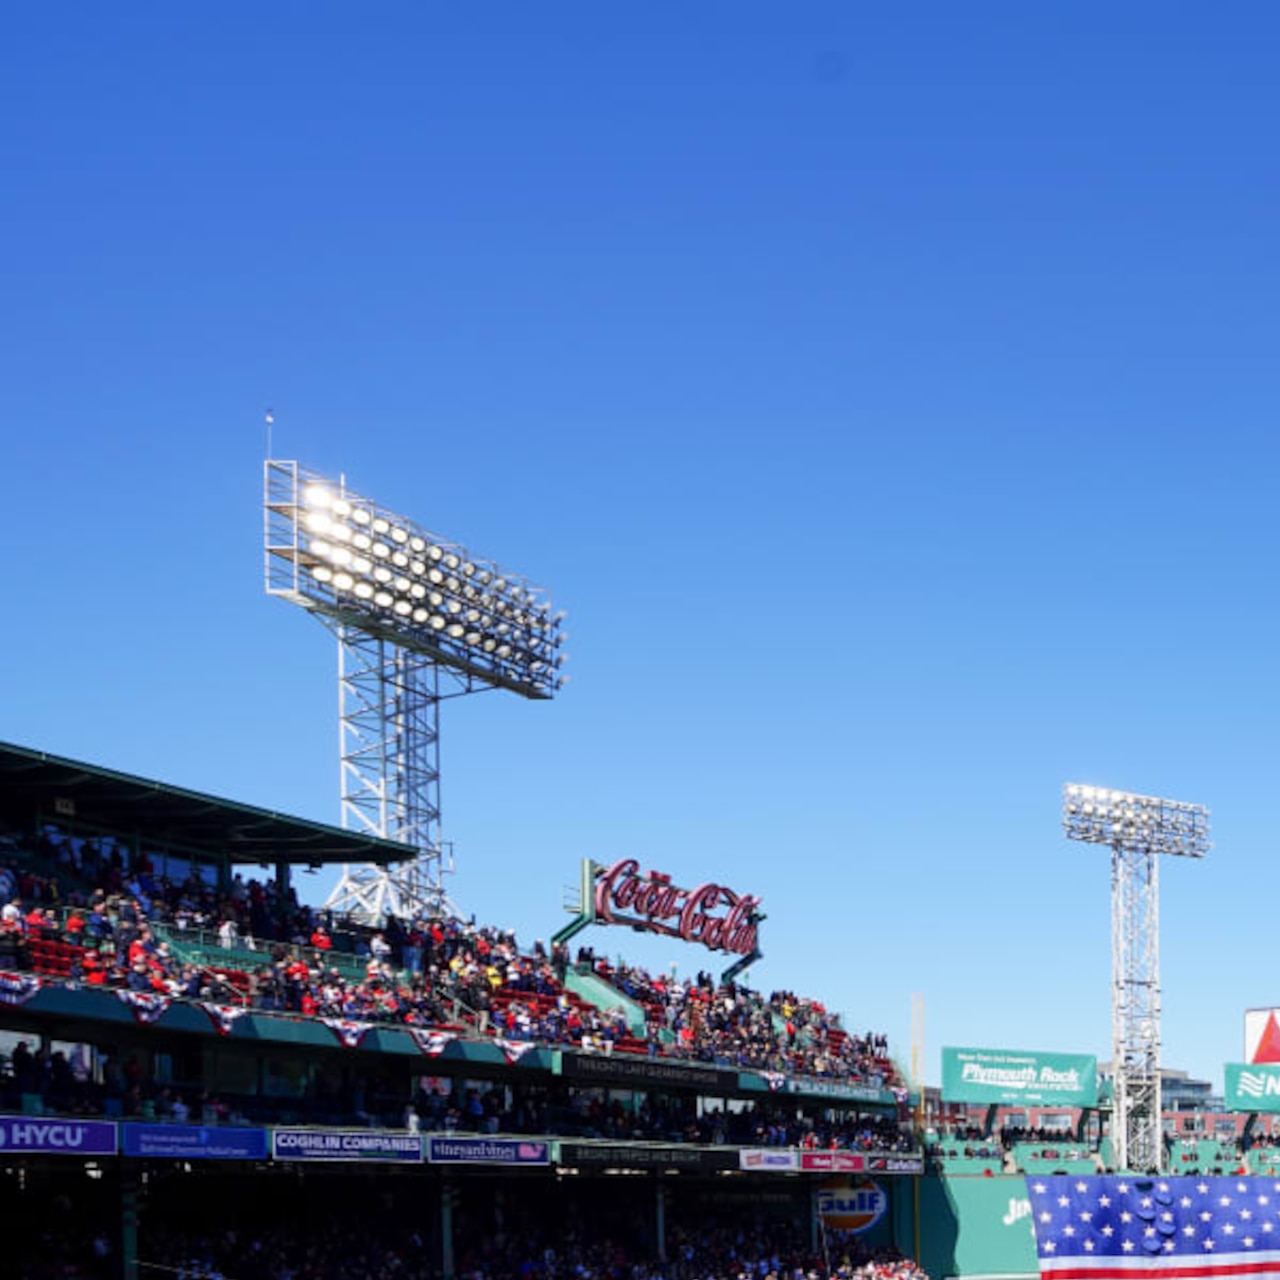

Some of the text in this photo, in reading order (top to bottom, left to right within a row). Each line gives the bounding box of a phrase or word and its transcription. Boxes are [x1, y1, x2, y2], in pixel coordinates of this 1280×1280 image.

[596, 860, 760, 954] Coca-Cola
[961, 1063, 1079, 1083] Plymouth Rock
[12, 1123, 83, 1147] HYCU
[276, 1133, 420, 1152] COGHLIN COMPANIES
[817, 1190, 881, 1213] Gulf
